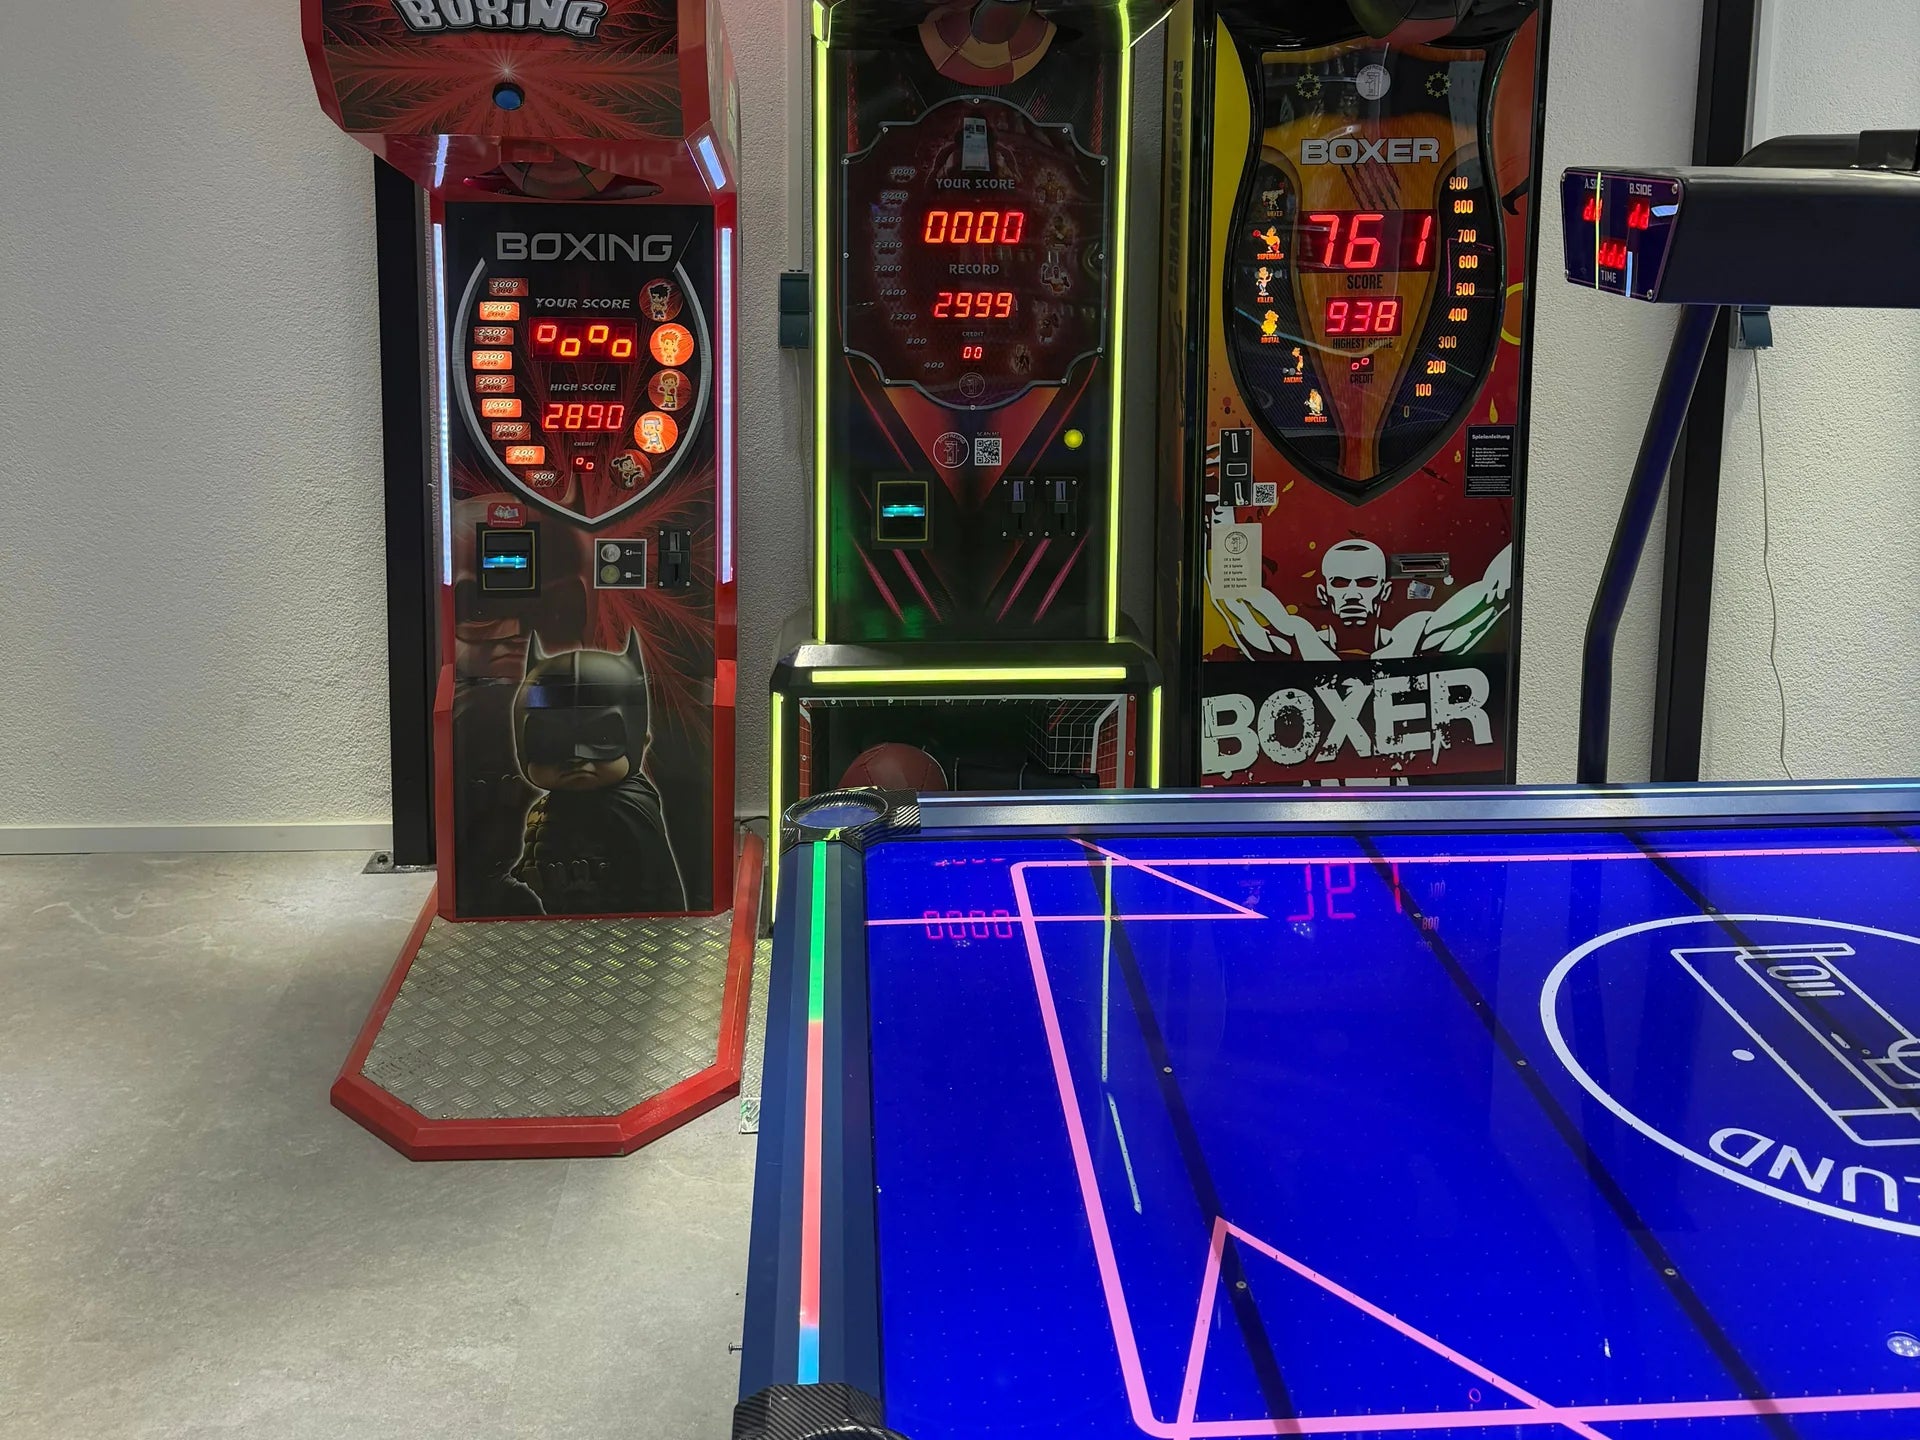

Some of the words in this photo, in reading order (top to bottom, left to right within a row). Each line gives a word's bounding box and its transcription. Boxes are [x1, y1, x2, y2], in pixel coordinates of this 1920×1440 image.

[399, 0, 605, 35] BOXING
[1301, 137, 1440, 165] BOXER
[936, 179, 971, 189] YOUR
[975, 179, 1015, 190] SCORE
[1449, 177, 1468, 190] 900
[1629, 183, 1653, 196] B.SIDE
[1454, 200, 1474, 214] 800
[924, 211, 1025, 243] 0000
[1309, 214, 1432, 268] 761
[1458, 229, 1477, 243] 700
[496, 231, 673, 262] BOXING
[1458, 255, 1478, 269] 600
[949, 264, 1000, 275] RECORD
[1347, 274, 1384, 290] SCORE
[1601, 270, 1617, 284] TIME
[1456, 282, 1475, 296] 500
[536, 298, 577, 309] YOUR
[582, 298, 631, 309] SCORE
[934, 292, 1013, 318] 2999
[1326, 301, 1398, 332] 938
[1448, 308, 1468, 322] 400
[1333, 338, 1365, 349] HIGHEST
[1368, 338, 1393, 349] SCORE
[1438, 336, 1457, 349] 300
[963, 346, 983, 359] 00
[1427, 360, 1446, 374] 200
[1350, 374, 1374, 384] CREDIT
[550, 383, 578, 392] HIGH
[580, 383, 617, 392] SCORE
[1415, 384, 1432, 397] 100
[545, 404, 625, 429] 2890
[1403, 405, 1410, 418] 0
[1201, 667, 1493, 776] BOXER
[1708, 1127, 1920, 1214] UND
